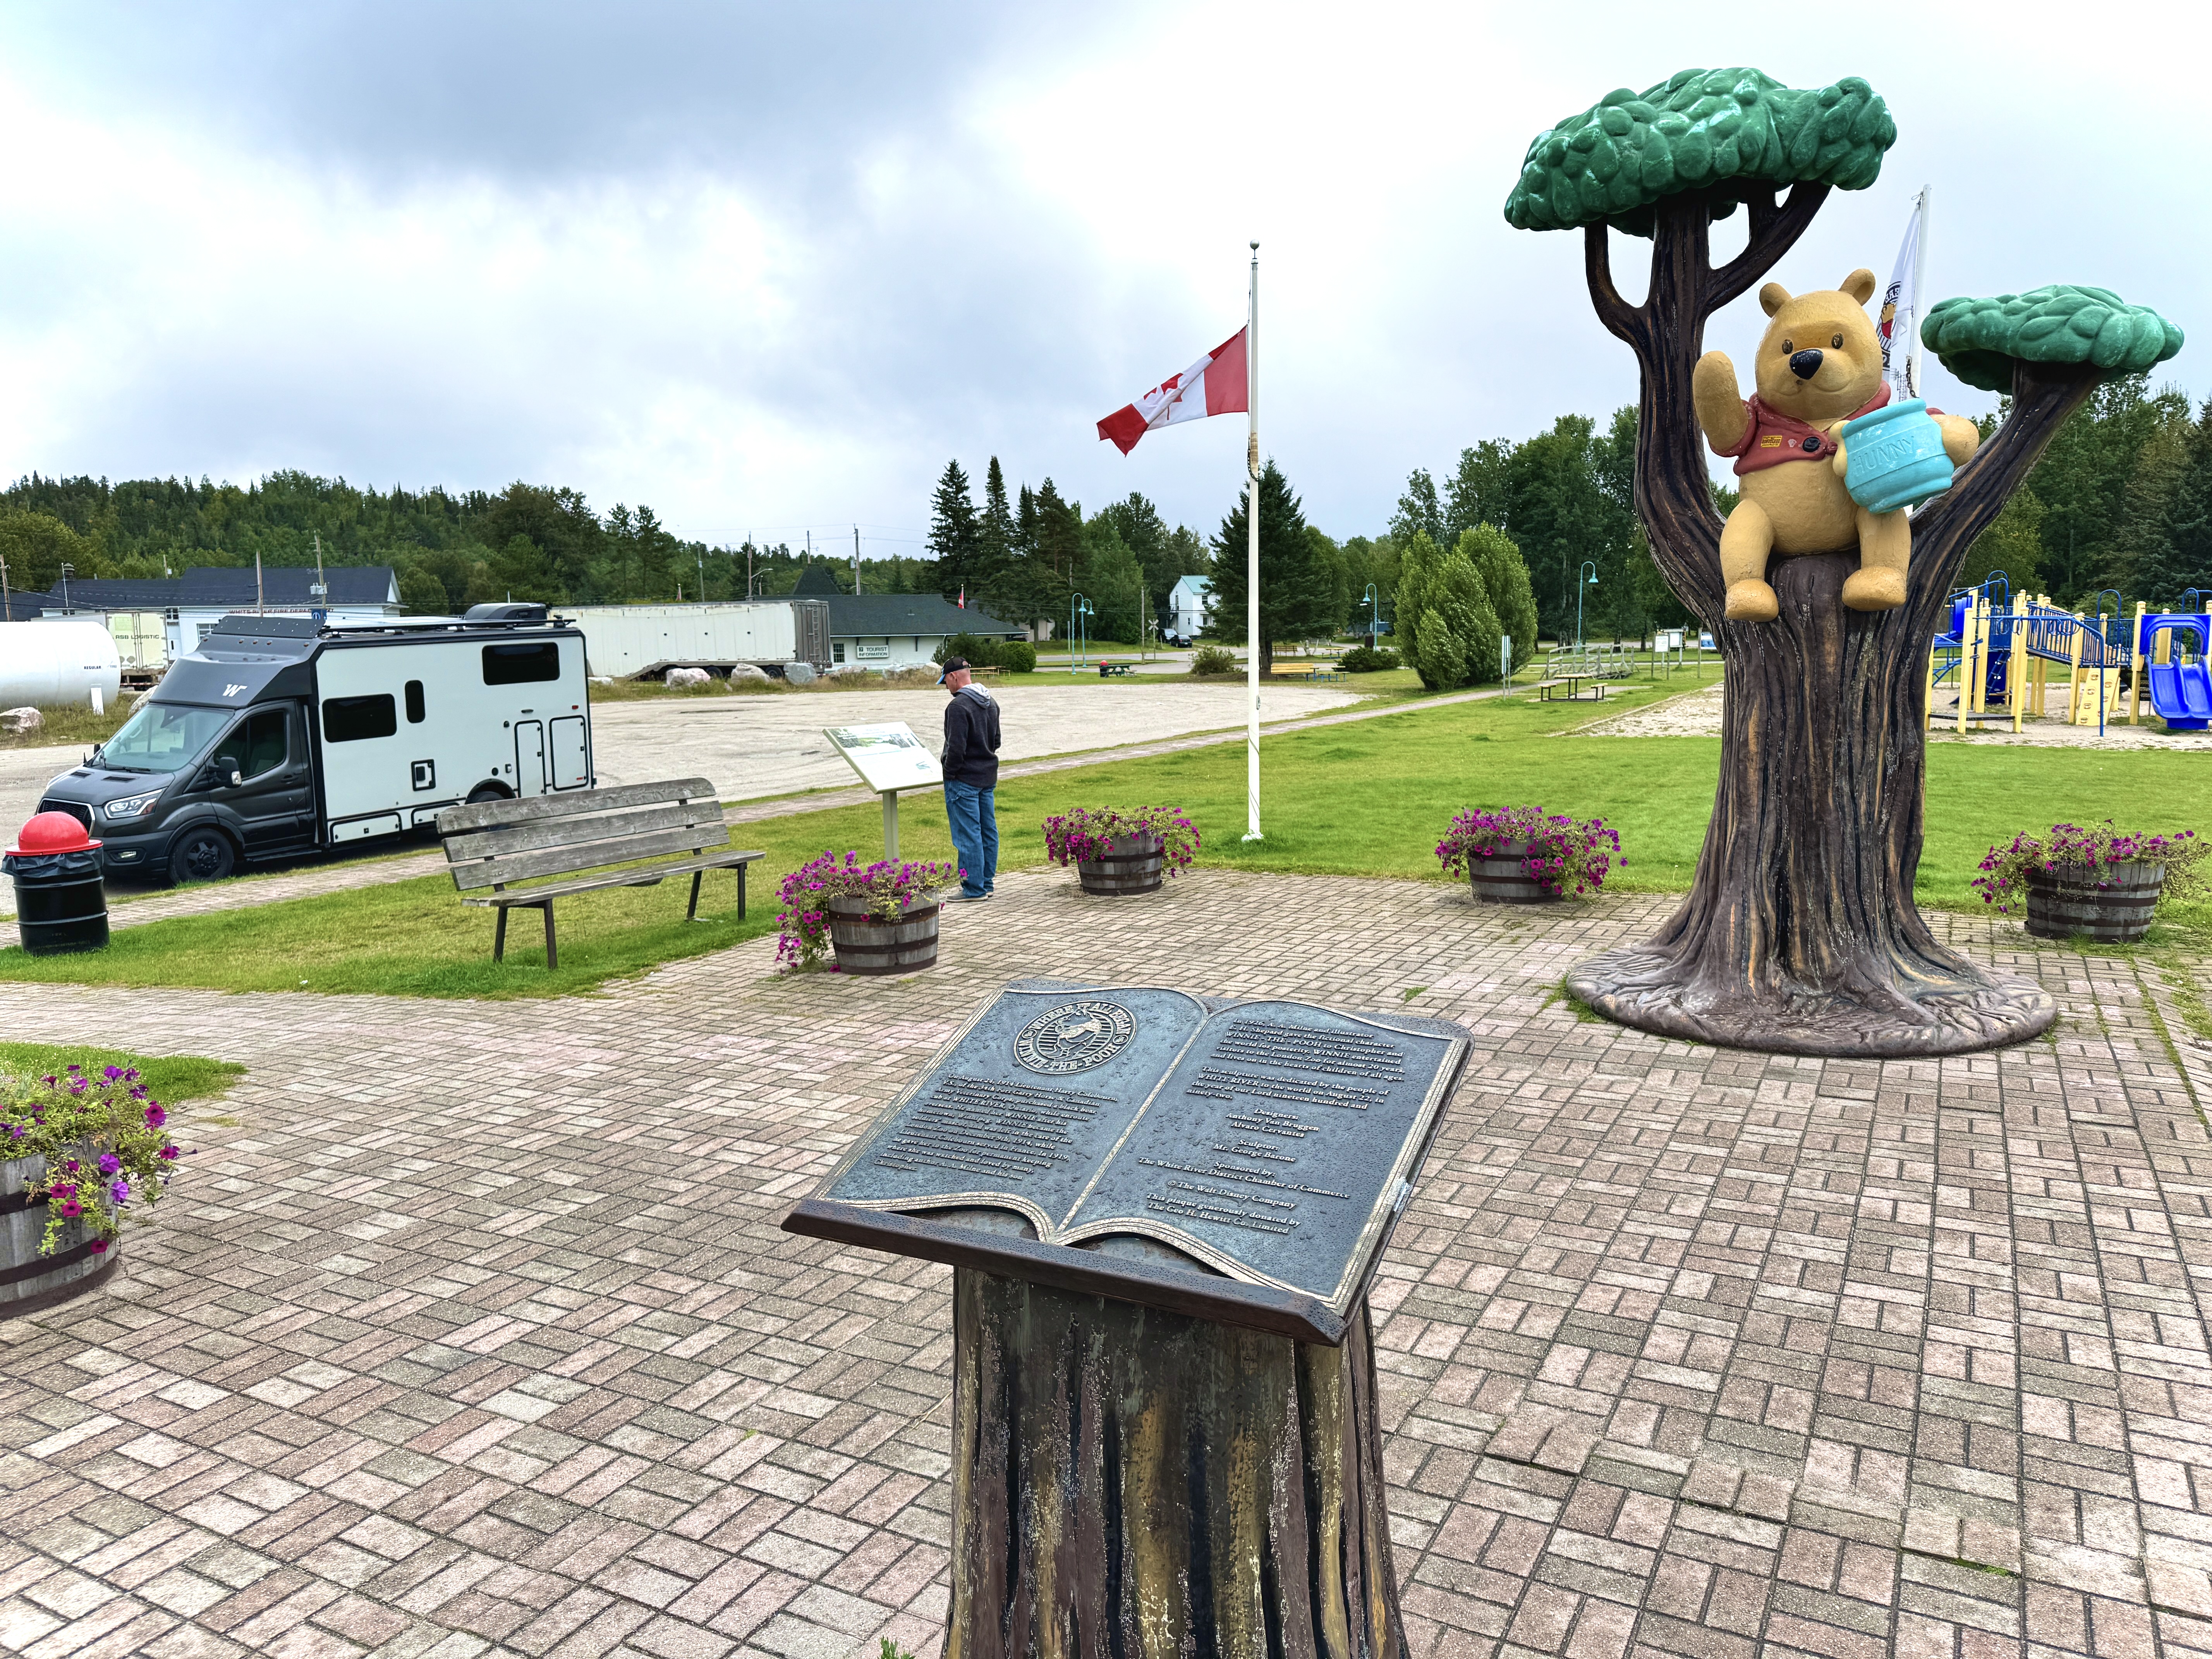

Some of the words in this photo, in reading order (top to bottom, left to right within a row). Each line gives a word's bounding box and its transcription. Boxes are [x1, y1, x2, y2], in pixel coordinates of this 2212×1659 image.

[1853, 436, 1914, 477] HUNNY
[1029, 1005, 1074, 1030] WHERE
[1089, 1003, 1115, 1015] ALL
[1249, 1027, 1284, 1037] Shepard
[1318, 1035, 1354, 1043] fictional
[1355, 1039, 1396, 1048] character
[1331, 1029, 1375, 1038] illustrator
[1223, 1032, 1261, 1040] WINNIE
[1332, 1044, 1387, 1056] Christopher
[1271, 1044, 1312, 1055] posterity.
[1311, 1049, 1351, 1058] WINNIE
[1351, 1054, 1402, 1064] entertained
[1270, 1052, 1304, 1060] London
[1336, 1060, 1368, 1068] almost
[1321, 1066, 1359, 1075] children
[1195, 1073, 1230, 1082] WHITE
[1229, 1077, 1261, 1086] RIVER
[1285, 1085, 1312, 1093] world
[1324, 1091, 1358, 1101] August
[1219, 1069, 1260, 1079] sculpture
[1276, 1076, 1318, 1086] dedicated
[1346, 1085, 1378, 1096] people
[1185, 1088, 1235, 1100] ninety-two.
[1272, 1092, 1312, 1101] nineteen
[1311, 1097, 1350, 1107] hundred
[1224, 1112, 1264, 1124] Anthony
[1281, 1120, 1321, 1132] Bruggen
[1252, 1108, 1301, 1121] Designers:
[1230, 1121, 1261, 1131] Alvaro
[1260, 1125, 1306, 1137] Cervantes
[1229, 1146, 1264, 1158] George
[1263, 1151, 1298, 1162] Barone
[1237, 1139, 1281, 1152] Sculptor:
[1136, 1157, 1157, 1165] The
[1154, 1160, 1184, 1170] White
[1182, 1164, 1209, 1174] River
[1207, 1169, 1245, 1180] District
[1243, 1175, 1288, 1188] Chamber
[1298, 1184, 1352, 1199] Commerce
[1212, 1161, 1262, 1175] Sponsored
[1259, 1169, 1278, 1178] by:
[1175, 1181, 1196, 1190] The
[1194, 1185, 1219, 1194] Walt
[1216, 1188, 1252, 1201] Disney
[1249, 1195, 1298, 1210] Company
[1144, 1192, 1167, 1201] This
[1165, 1196, 1199, 1209] plaque
[1196, 1202, 1249, 1218] generously
[1248, 1211, 1289, 1224] donated
[1287, 1218, 1303, 1228] by
[1146, 1202, 1166, 1211] The
[1165, 1205, 1185, 1214] Geo
[1199, 1211, 1233, 1223] Hewitt
[1231, 1218, 1250, 1226] Co.
[1250, 1221, 1291, 1234] Limited
